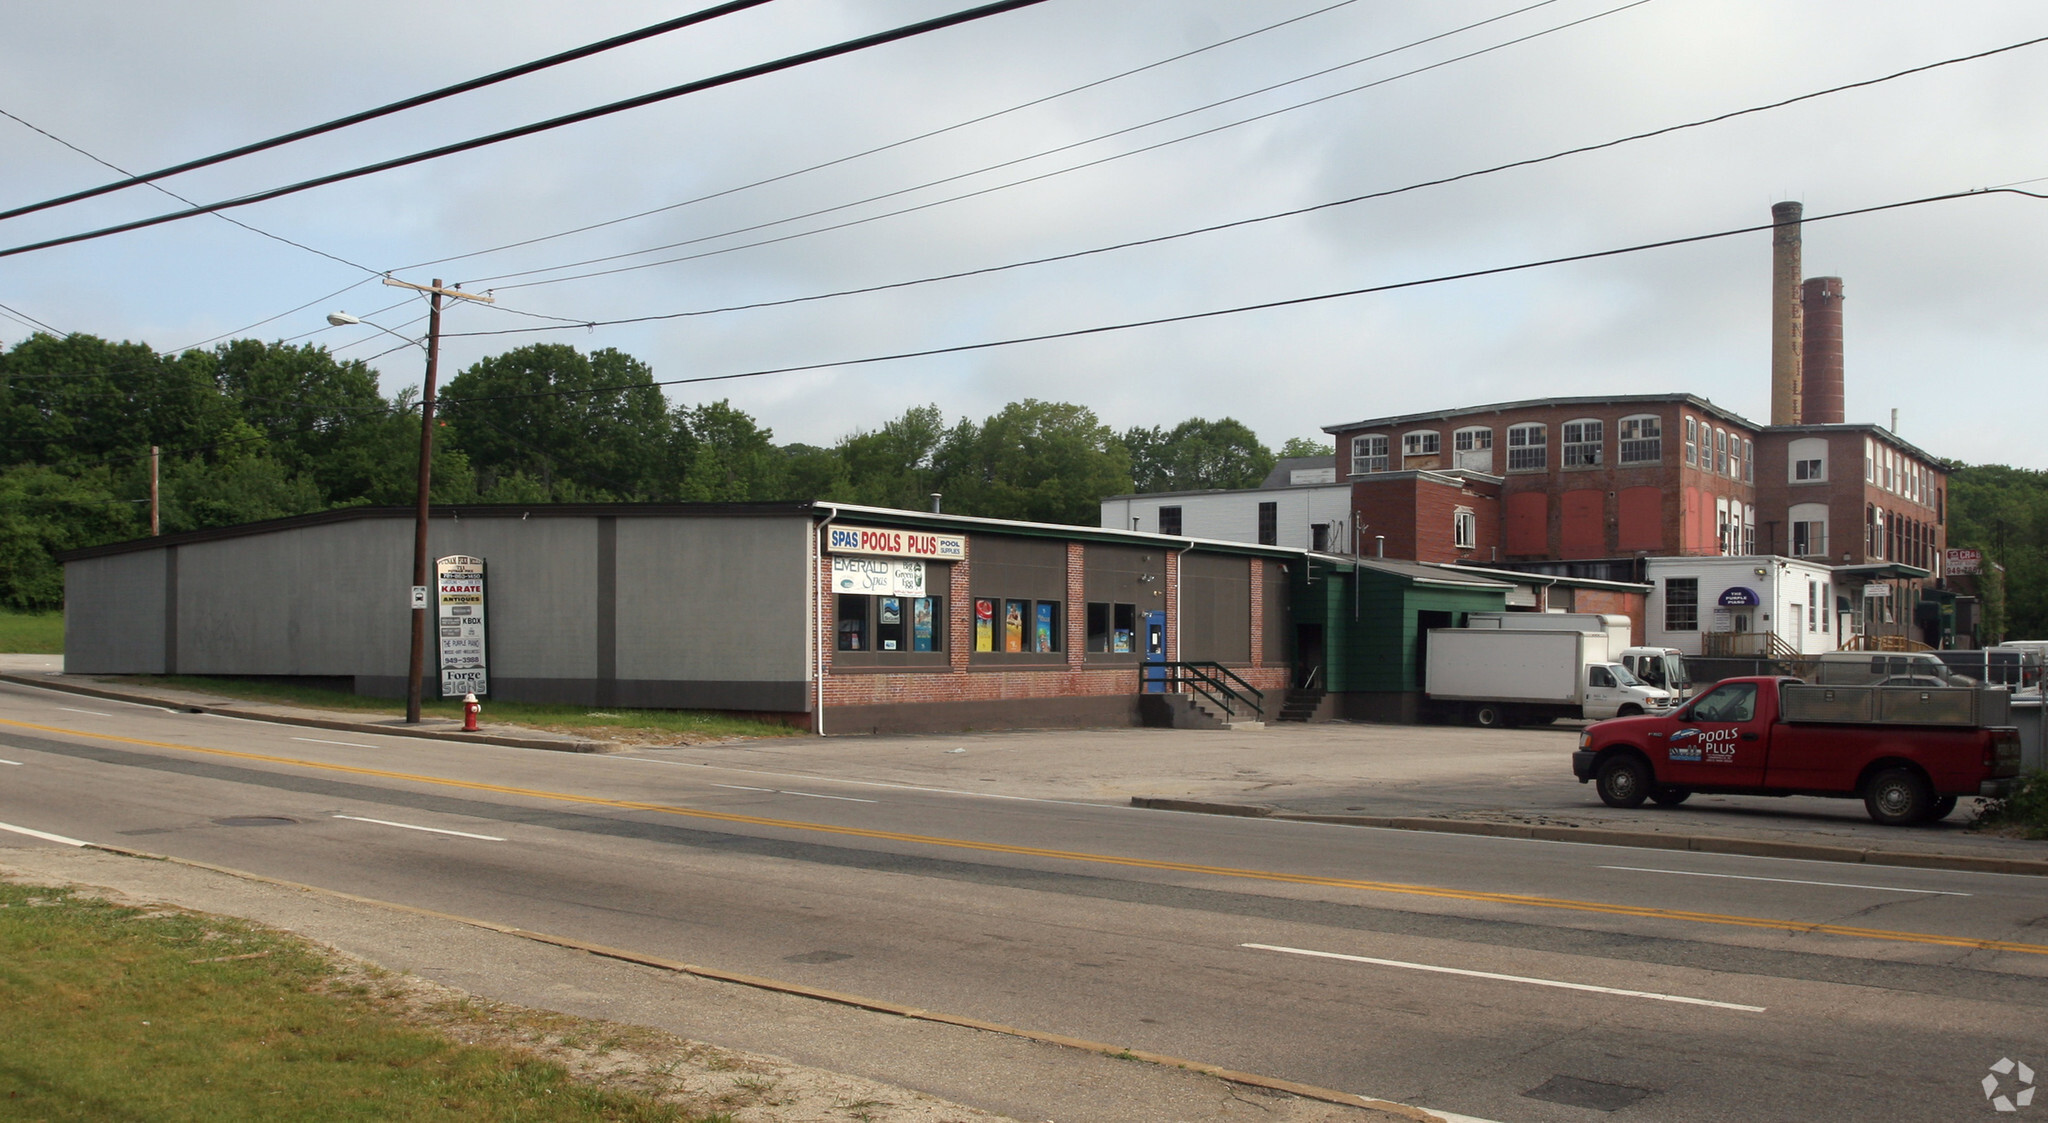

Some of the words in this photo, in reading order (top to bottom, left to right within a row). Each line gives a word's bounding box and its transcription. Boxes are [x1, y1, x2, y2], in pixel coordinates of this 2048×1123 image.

[832, 530, 858, 547] SPAS
[861, 531, 901, 552] POOLS
[908, 535, 937, 554] PLUS
[940, 547, 960, 555] SUPPLIES
[834, 556, 889, 574] EMERALD
[903, 560, 913, 572] Big
[895, 569, 913, 579] Green
[862, 571, 888, 591] Spas
[902, 578, 913, 589] Egg
[441, 585, 481, 593] KARATE
[462, 617, 481, 625] KBOX
[447, 671, 481, 681] Forge
[442, 680, 486, 694] SIGNS
[1698, 727, 1738, 744] POOLS
[1706, 743, 1736, 755] PLUS
